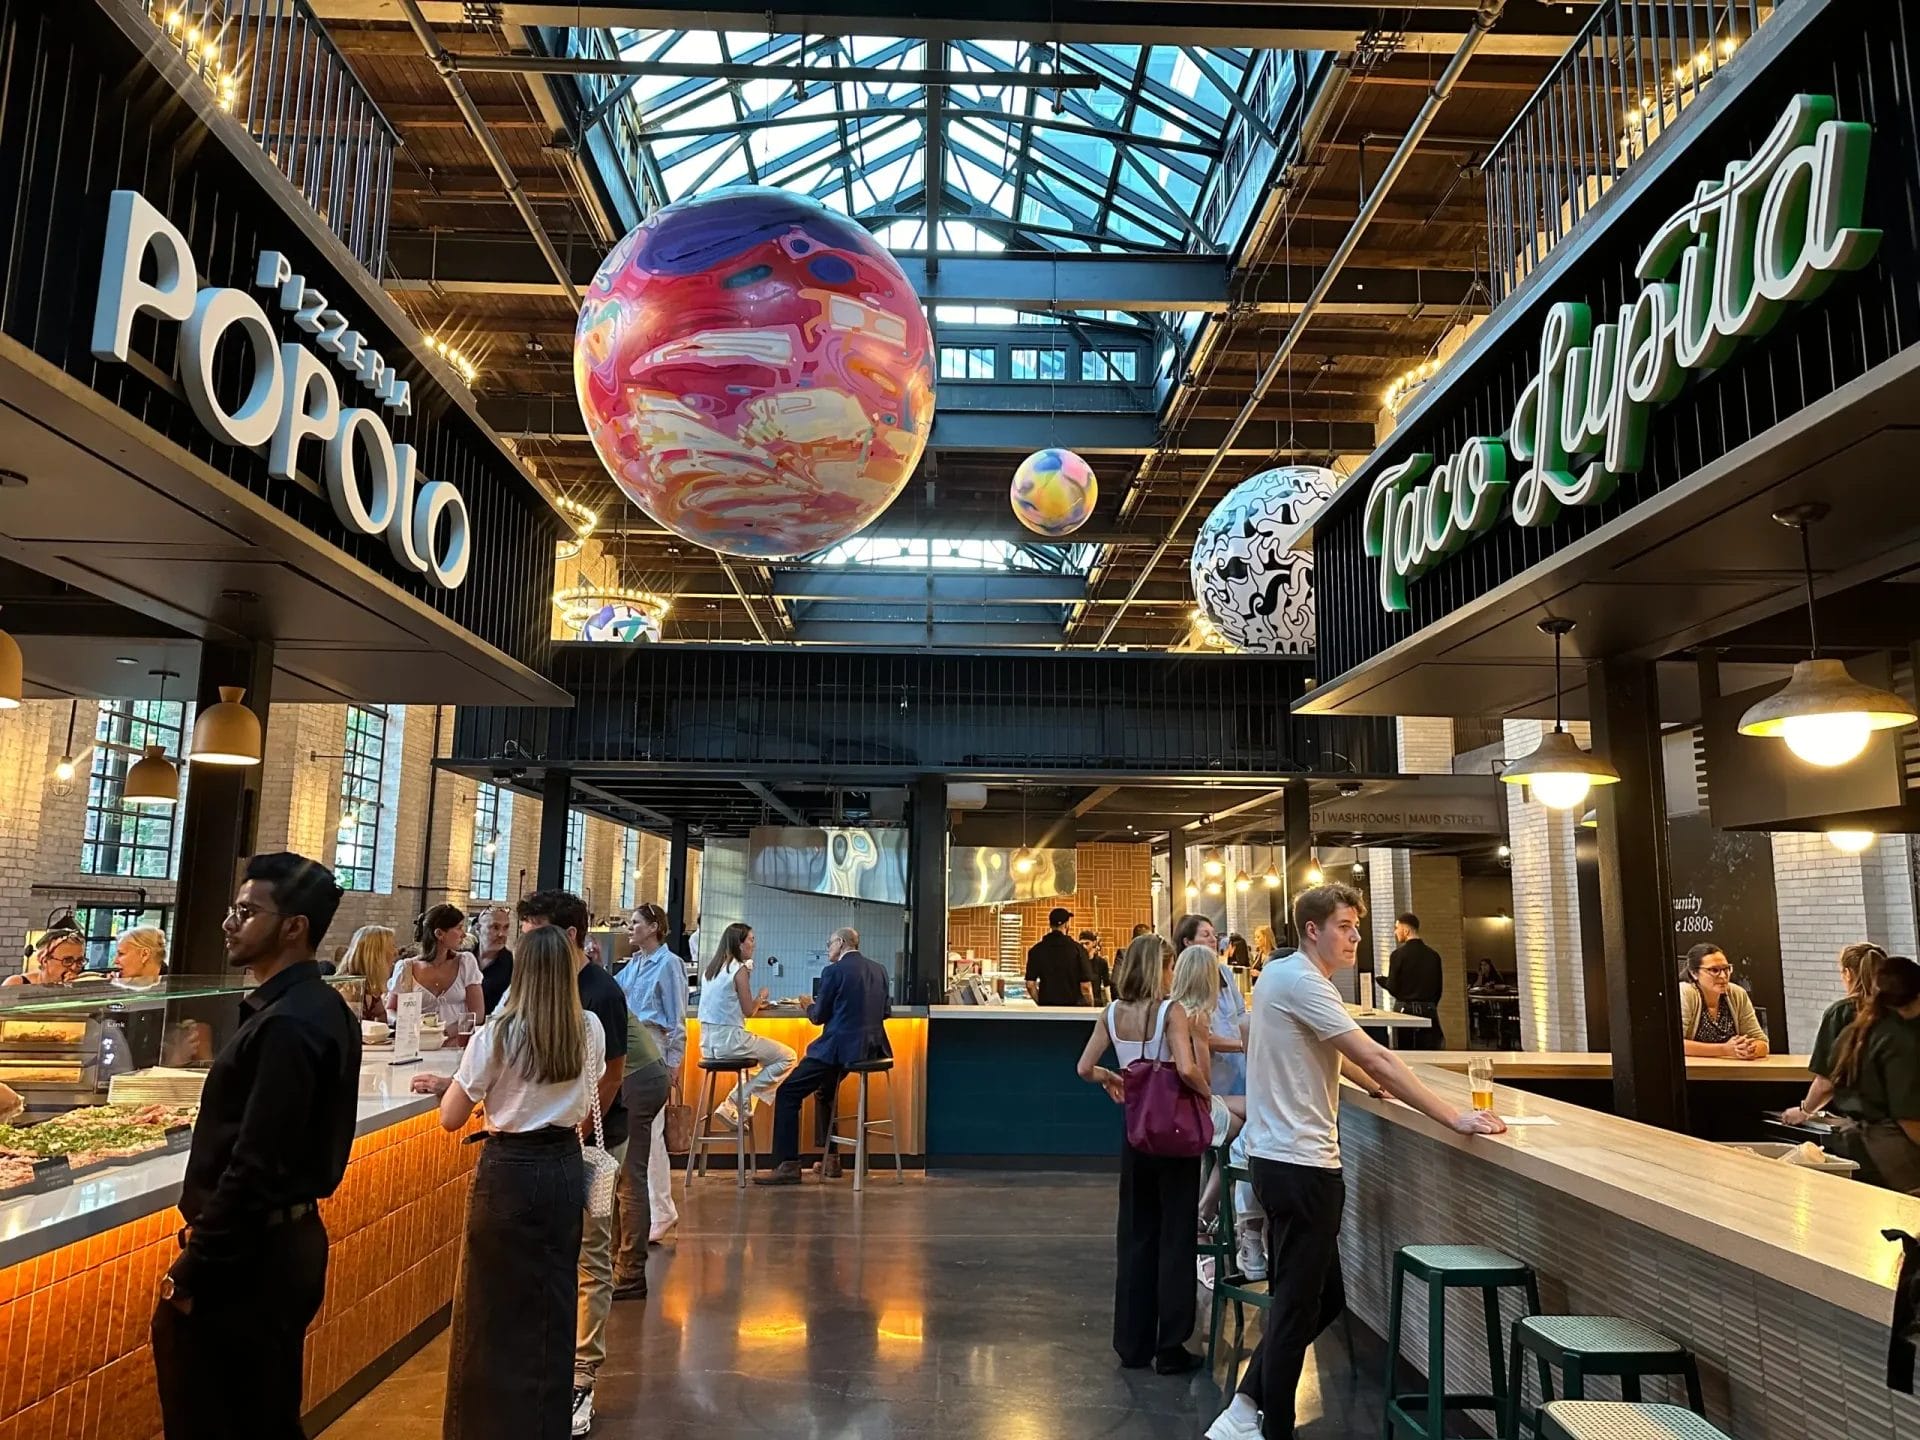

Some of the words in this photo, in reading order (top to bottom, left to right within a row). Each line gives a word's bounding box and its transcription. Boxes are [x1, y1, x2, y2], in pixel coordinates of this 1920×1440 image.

[91, 190, 471, 590] POPOLO
[256, 250, 412, 416] PIZZERIA
[1363, 435, 1510, 613] Taco
[1510, 93, 1884, 528] Lupita
[1327, 812, 1401, 825] WASHROOMS
[1408, 813, 1441, 825] MAUD
[1443, 813, 1485, 825] STREET
[1682, 915, 1713, 932] 1880s
